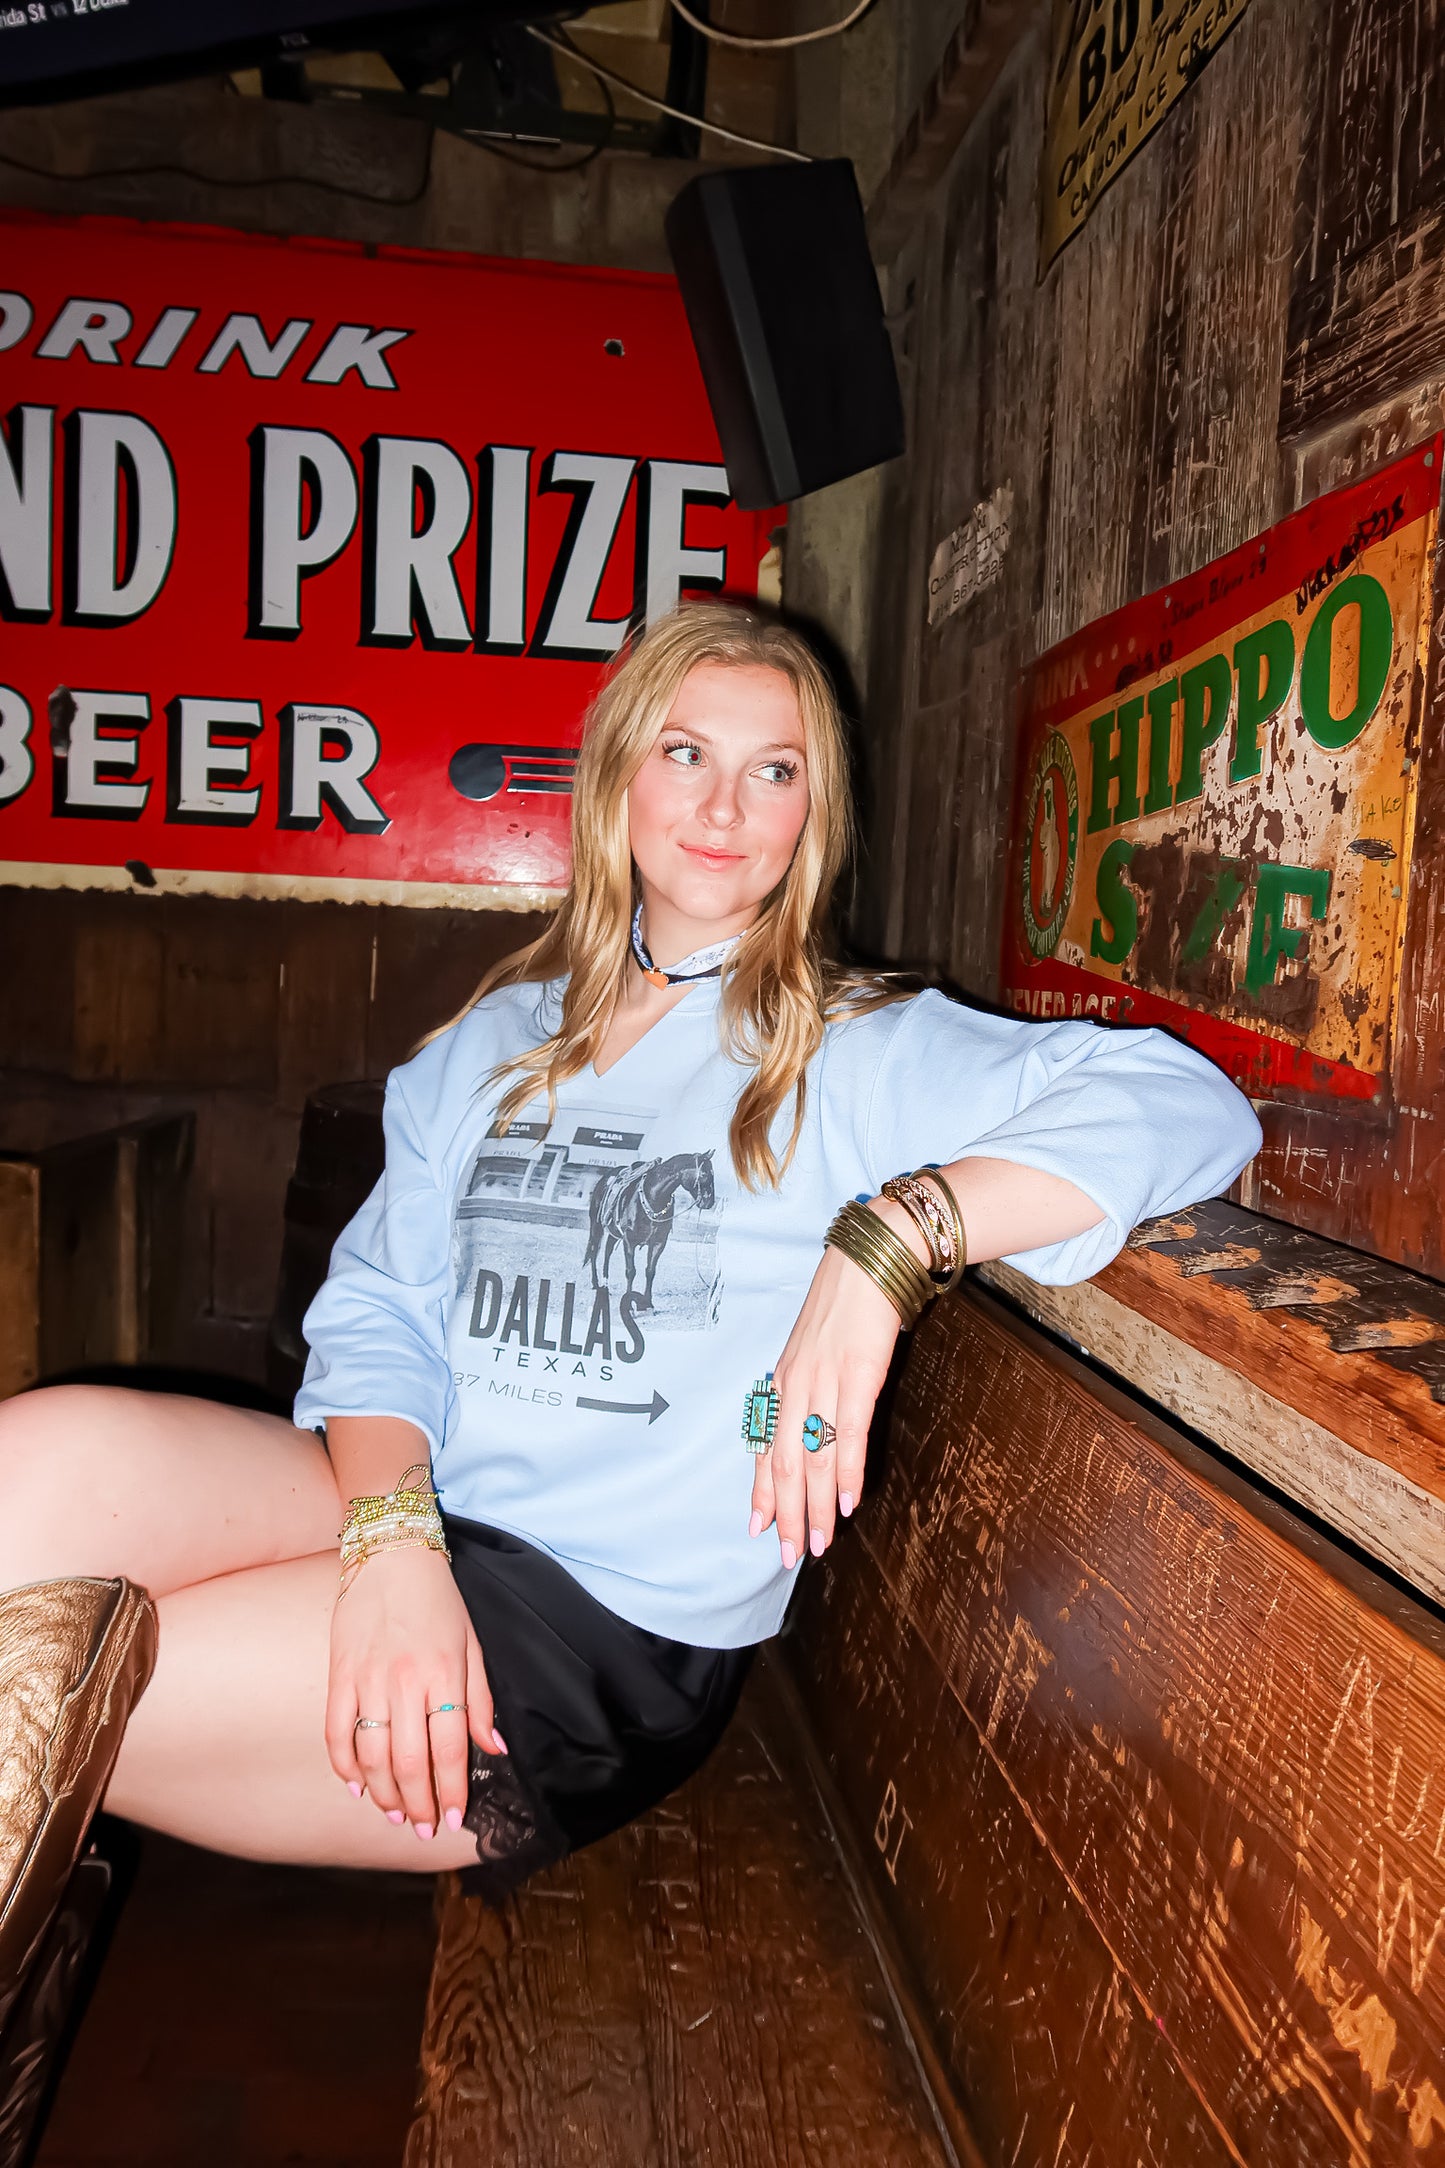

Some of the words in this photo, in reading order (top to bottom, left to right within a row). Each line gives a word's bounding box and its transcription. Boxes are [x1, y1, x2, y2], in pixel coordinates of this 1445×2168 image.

[1138, 72, 1168, 129] ICE
[245, 423, 730, 660] PRIZE
[1086, 573, 1394, 834] HIPPO
[468, 1268, 645, 1363] DALLAS
[488, 1380, 563, 1407] MILES
[492, 1347, 614, 1381] TEXAS
